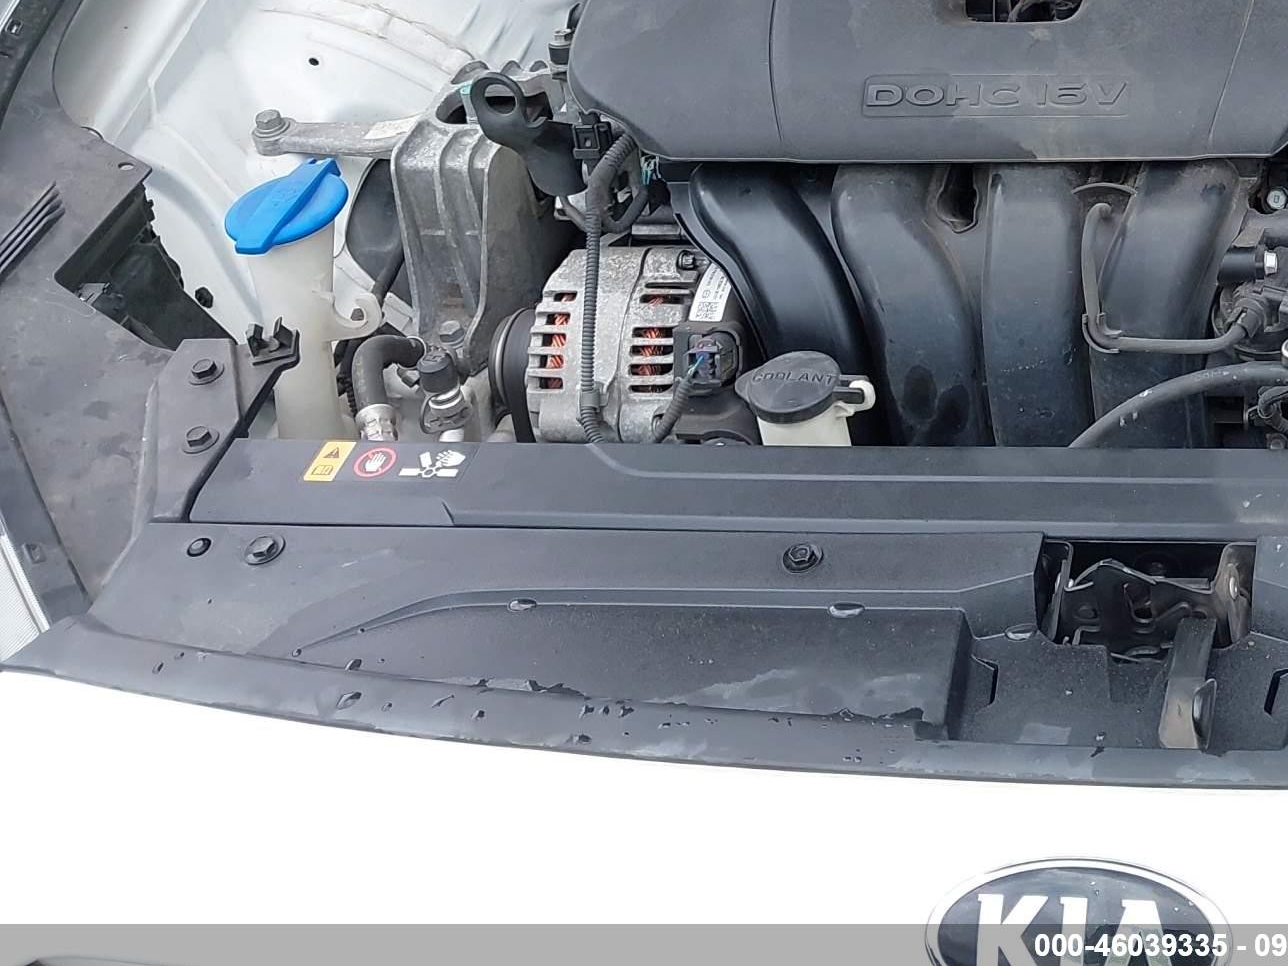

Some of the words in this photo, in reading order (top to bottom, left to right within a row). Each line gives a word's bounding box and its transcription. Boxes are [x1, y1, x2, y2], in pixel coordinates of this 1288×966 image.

[866, 83, 1021, 107] DOHC
[1036, 82, 1128, 106] 16V
[752, 370, 834, 385] COOLANT
[976, 893, 1174, 966] KIA
